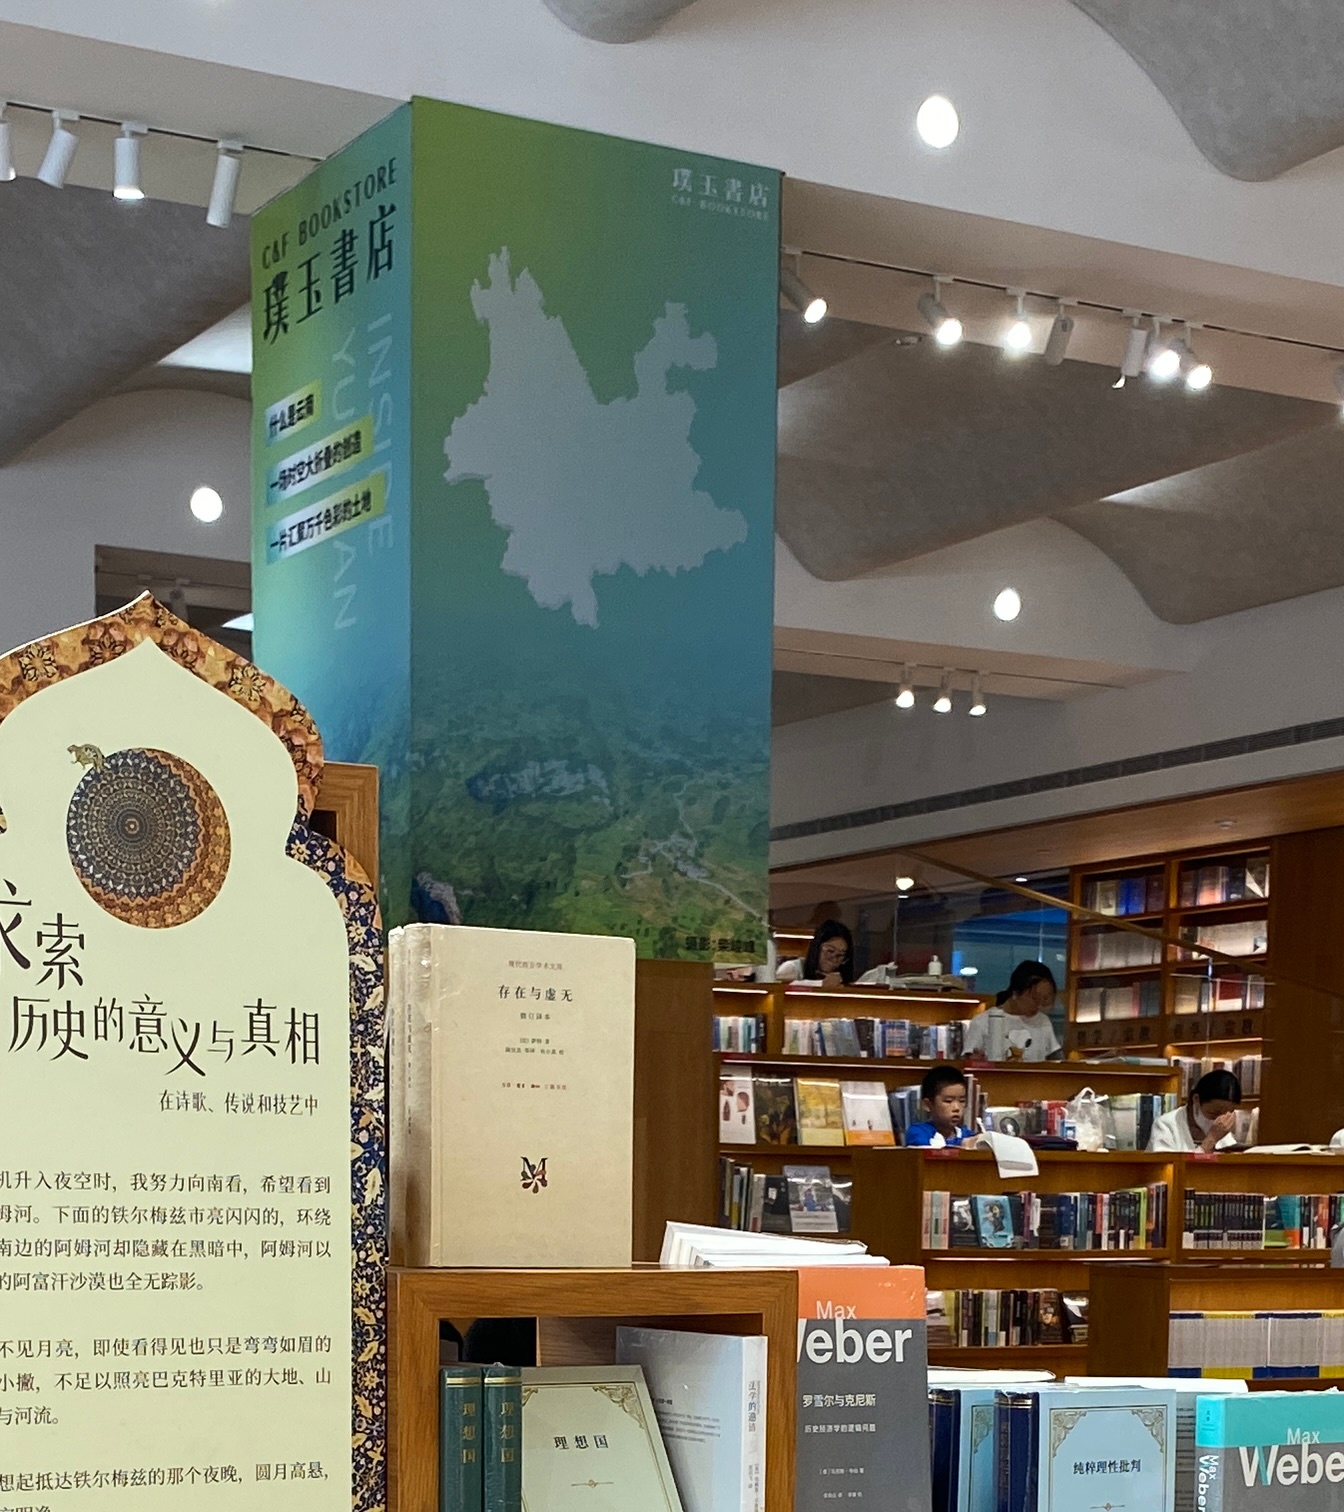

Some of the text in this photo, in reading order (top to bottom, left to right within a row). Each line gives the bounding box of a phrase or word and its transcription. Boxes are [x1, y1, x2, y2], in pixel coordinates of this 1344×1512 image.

[671, 167, 769, 209] 璞玉書店
[262, 156, 397, 270] C&F BOOKSTORE
[262, 202, 397, 346] 璞玉書店
[498, 984, 574, 1003] 存在与虚无
[8, 994, 321, 1077] 历史的意义与真相
[158, 1088, 320, 1117] 在诗歌、传说和技艺中
[815, 1300, 857, 1320] Max
[802, 1393, 877, 1408] 罗雪尔与克尼斯
[462, 1401, 477, 1465] 理想国
[499, 1401, 515, 1464] 理想国
[553, 1434, 610, 1451] 理想国
[1286, 1427, 1322, 1446] Max
[1072, 1458, 1142, 1477] 纯粹理性批判
[1207, 1453, 1220, 1482] Max
